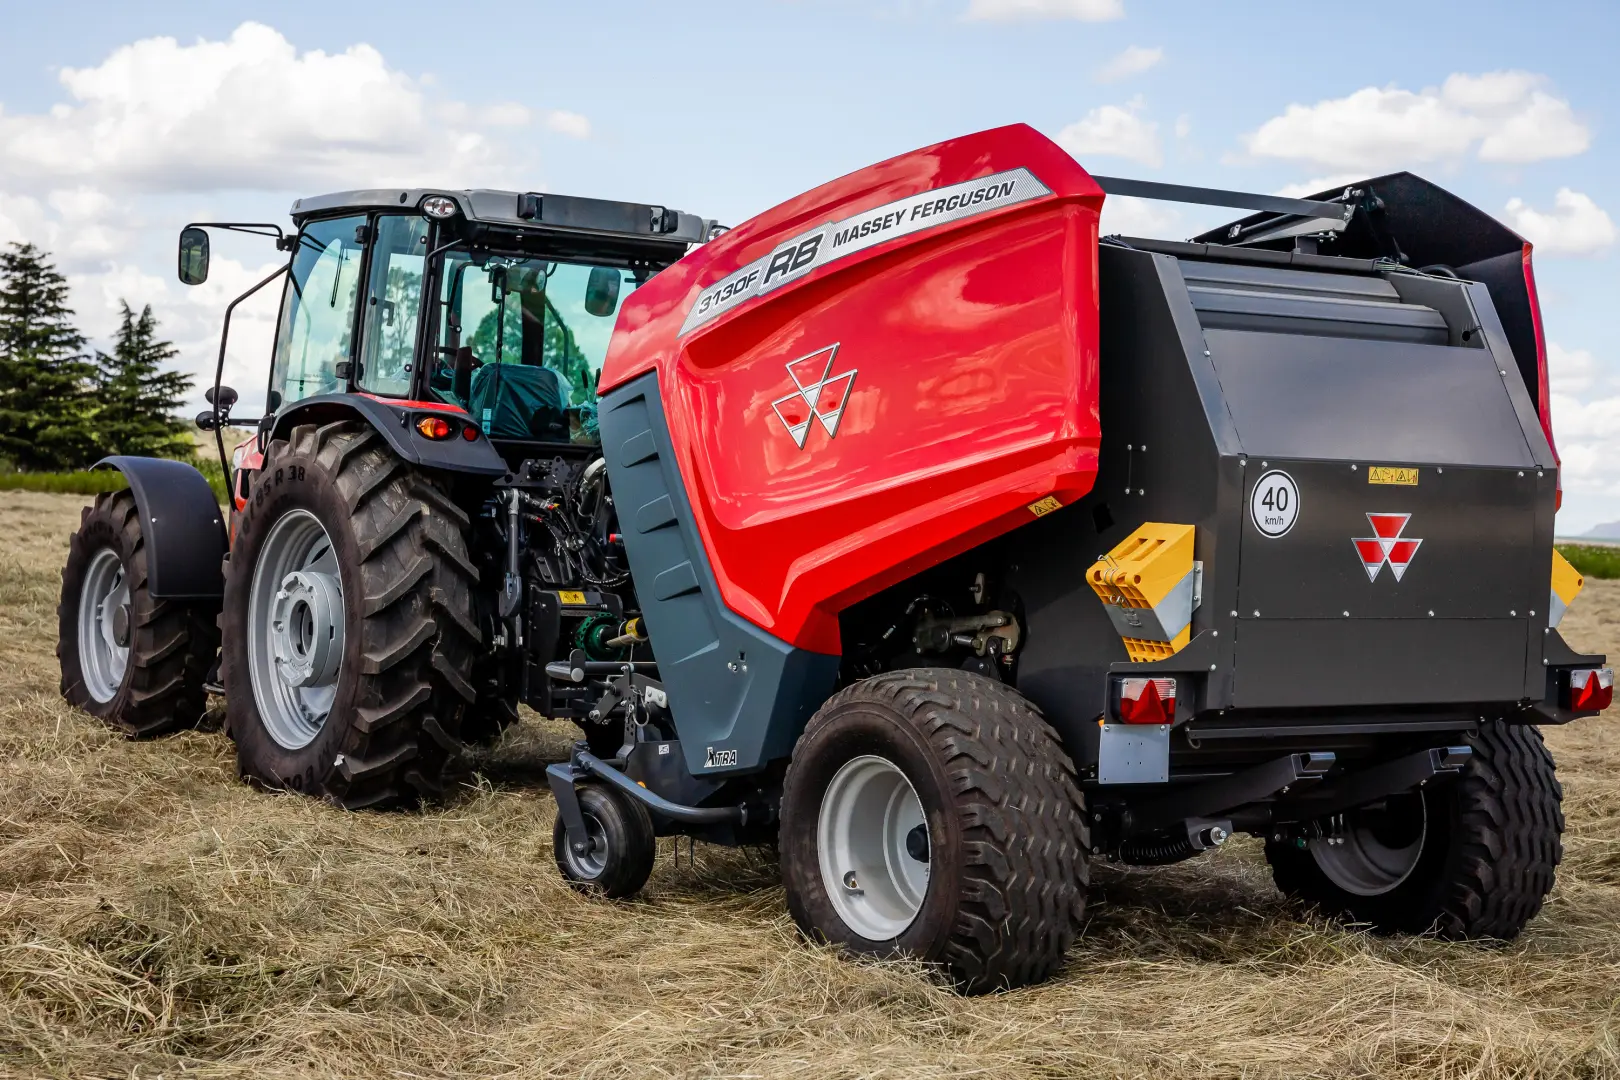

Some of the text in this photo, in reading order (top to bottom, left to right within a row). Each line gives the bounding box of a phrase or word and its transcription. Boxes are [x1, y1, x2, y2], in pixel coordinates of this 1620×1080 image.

[698, 180, 1016, 315] 3130F RB MASSEY FERGUSON
[288, 465, 305, 482] 38
[1261, 486, 1289, 512] 40
[1264, 515, 1284, 526] km/h
[704, 746, 737, 768] XTRA
